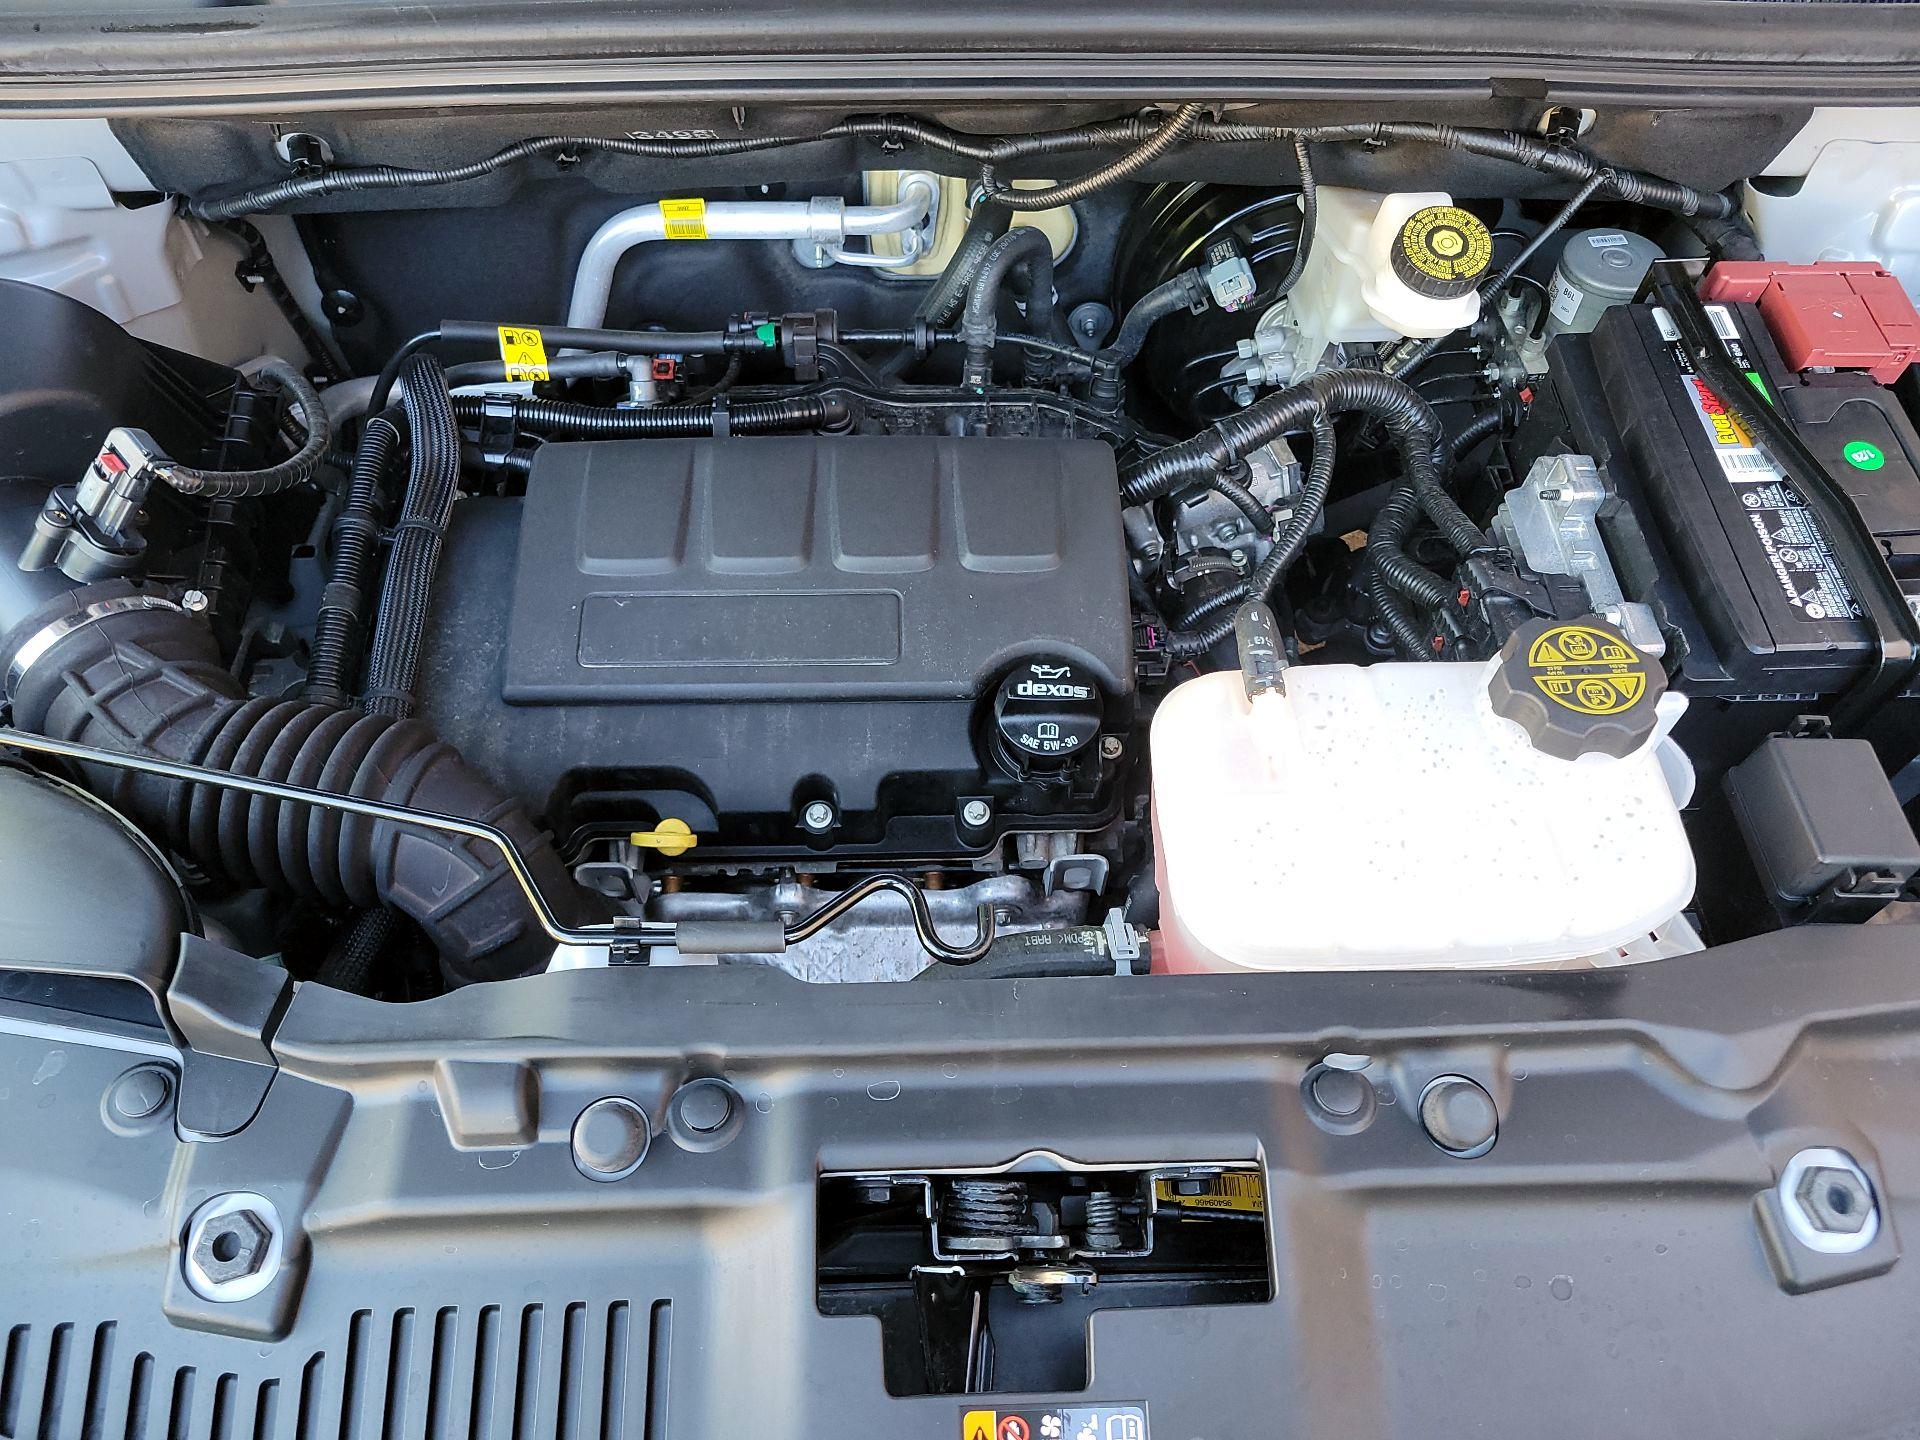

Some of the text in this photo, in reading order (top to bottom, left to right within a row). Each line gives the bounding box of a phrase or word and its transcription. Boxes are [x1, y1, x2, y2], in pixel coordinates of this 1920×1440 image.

[1017, 680, 1091, 699] dexos
[1020, 734, 1079, 751] SAE 5W-30
